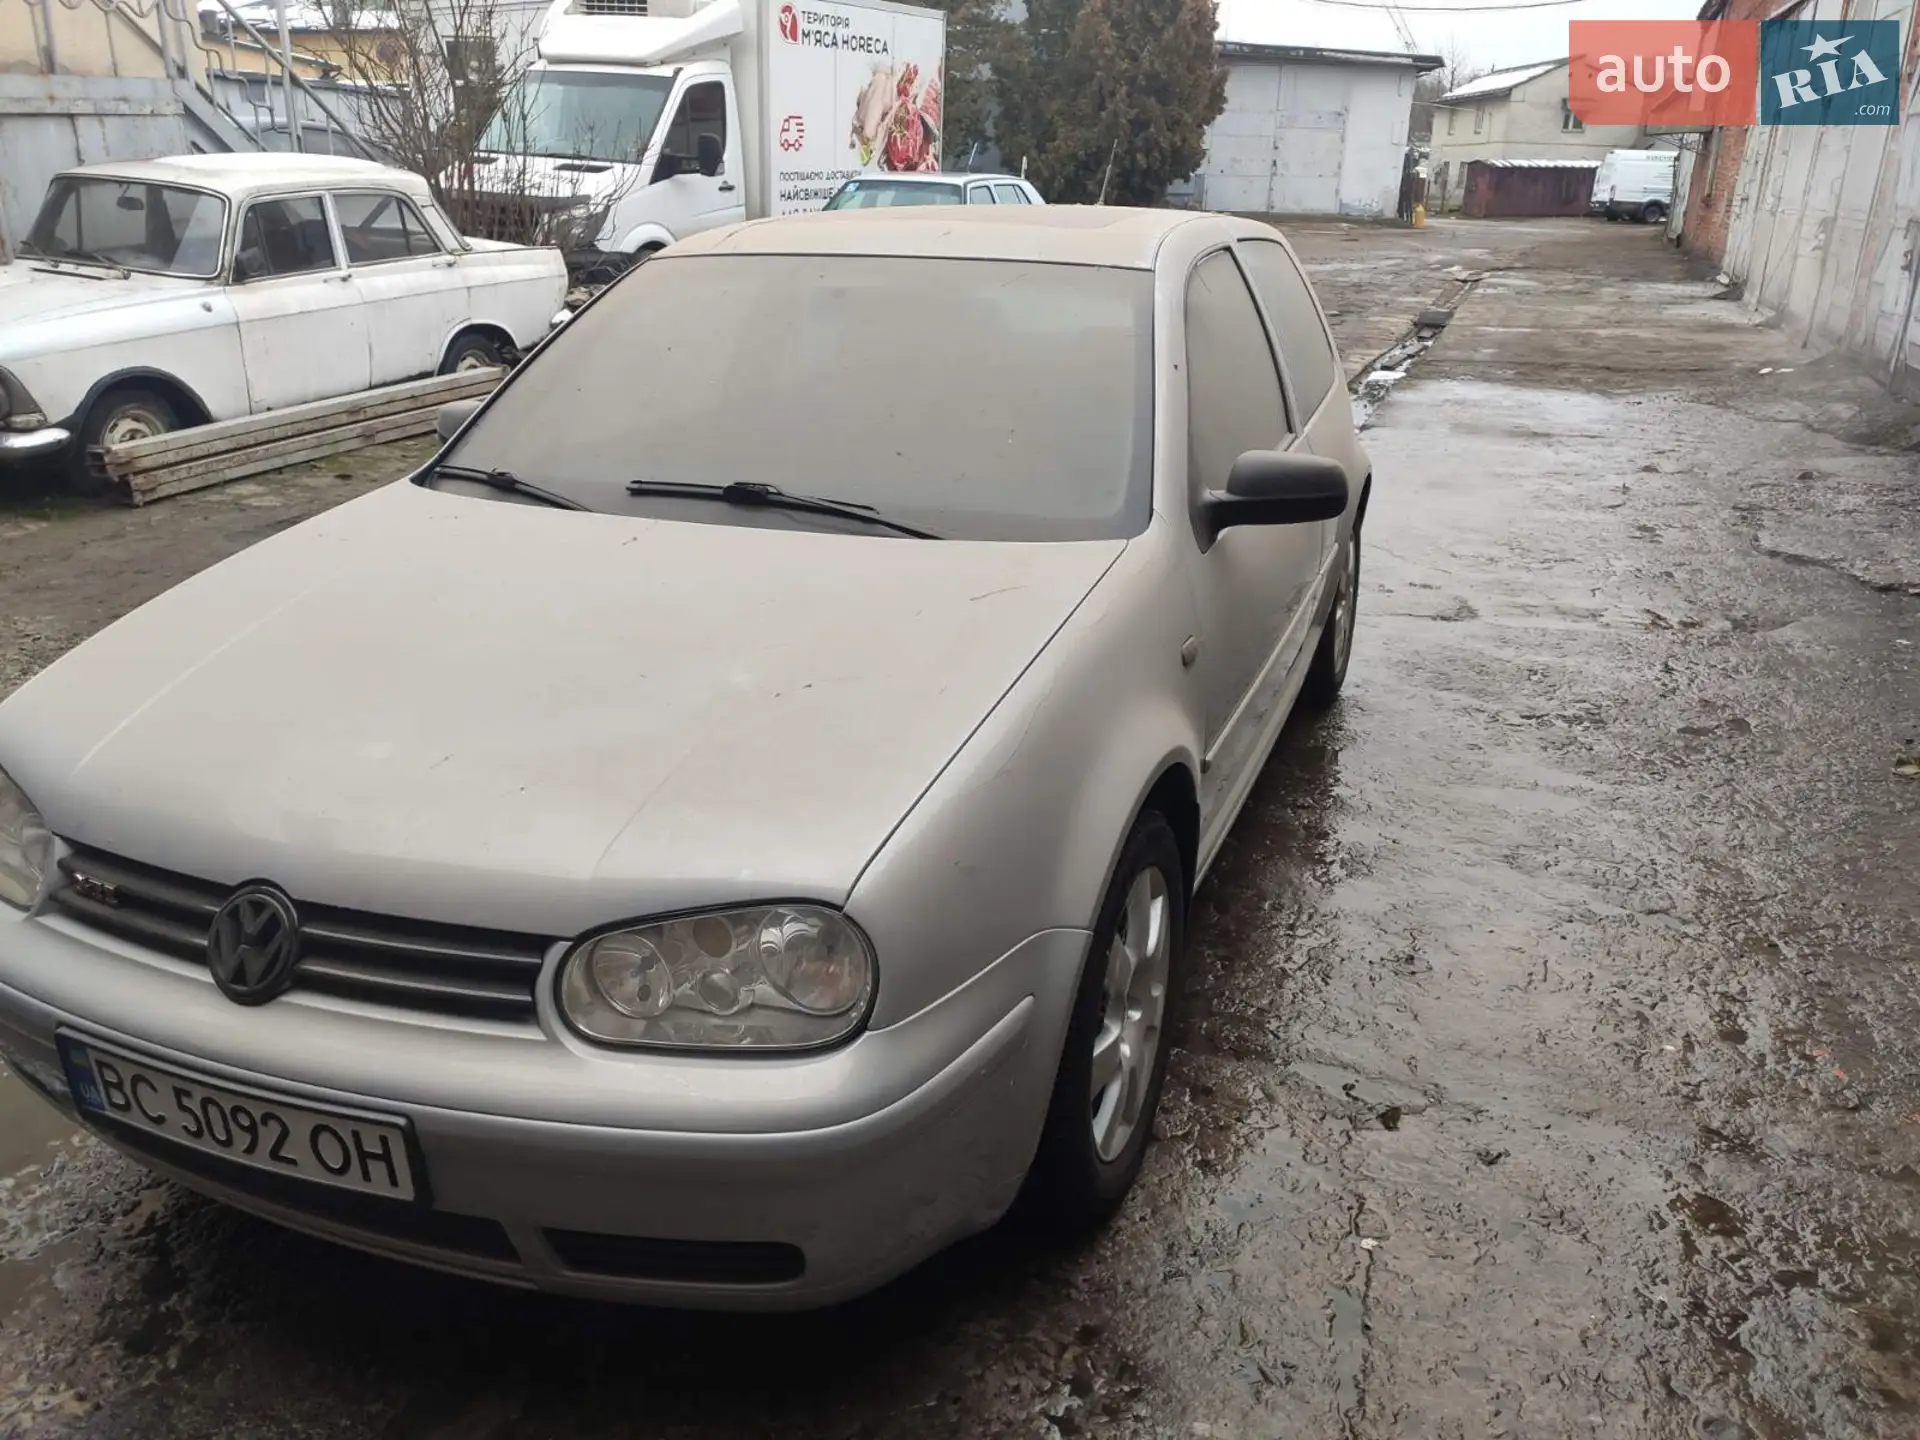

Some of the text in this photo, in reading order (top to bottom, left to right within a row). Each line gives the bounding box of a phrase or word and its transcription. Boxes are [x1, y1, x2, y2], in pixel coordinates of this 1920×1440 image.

[801, 11, 850, 29] ТЕРИТОРІЯ
[801, 28, 889, 55] М'ЯСА HORECA
[779, 171, 823, 182] ПОСПІШАЄМО
[779, 185, 834, 202] НАЙСВІЖІШЕ
[96, 1059, 399, 1188] BC 5092 OH
